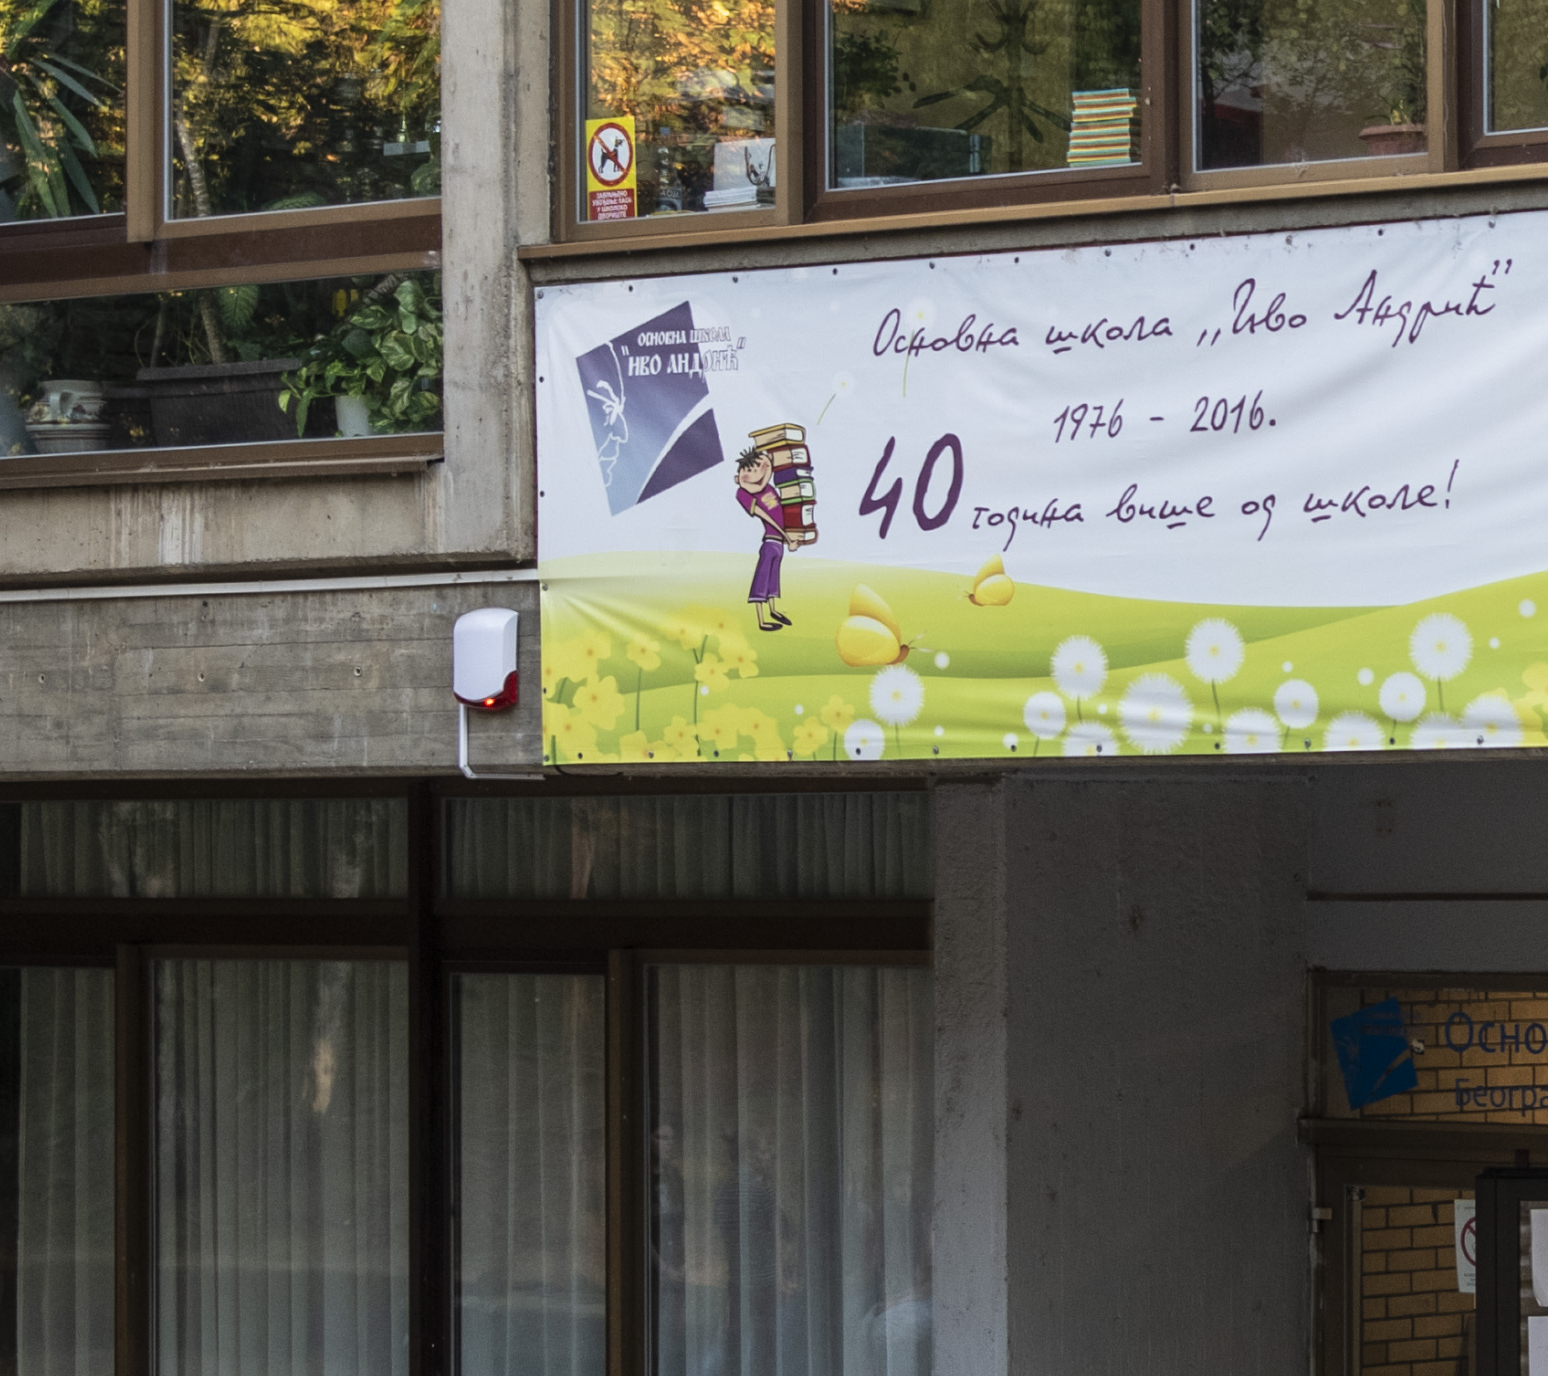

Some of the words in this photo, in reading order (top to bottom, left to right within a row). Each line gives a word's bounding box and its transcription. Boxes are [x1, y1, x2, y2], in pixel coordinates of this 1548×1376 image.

[637, 330, 687, 347] ОСНОВНА
[872, 309, 1020, 357] Основна
[1045, 315, 1174, 354] школа
[1053, 399, 1125, 444] 1976
[1189, 391, 1278, 434] 2016.
[858, 433, 965, 540] 40
[972, 497, 1085, 552] година
[1105, 483, 1216, 530] више
[1241, 495, 1278, 541] од
[1304, 458, 1461, 522] школе!
